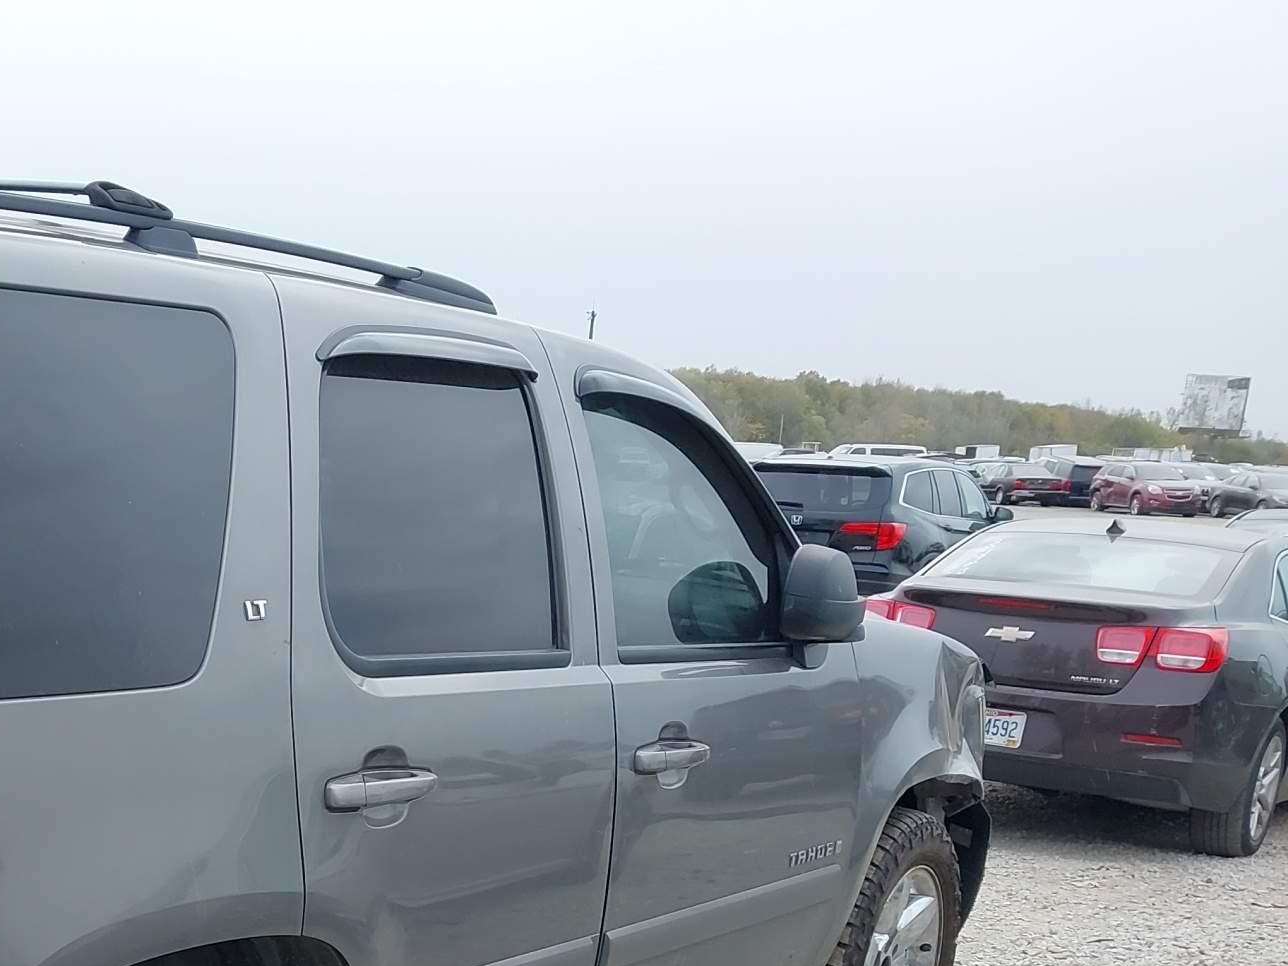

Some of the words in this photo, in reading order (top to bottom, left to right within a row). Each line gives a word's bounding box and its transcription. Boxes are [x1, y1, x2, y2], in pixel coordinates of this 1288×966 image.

[244, 600, 268, 621] LT
[984, 718, 1018, 738] 4592
[789, 842, 833, 867] TAHOE
